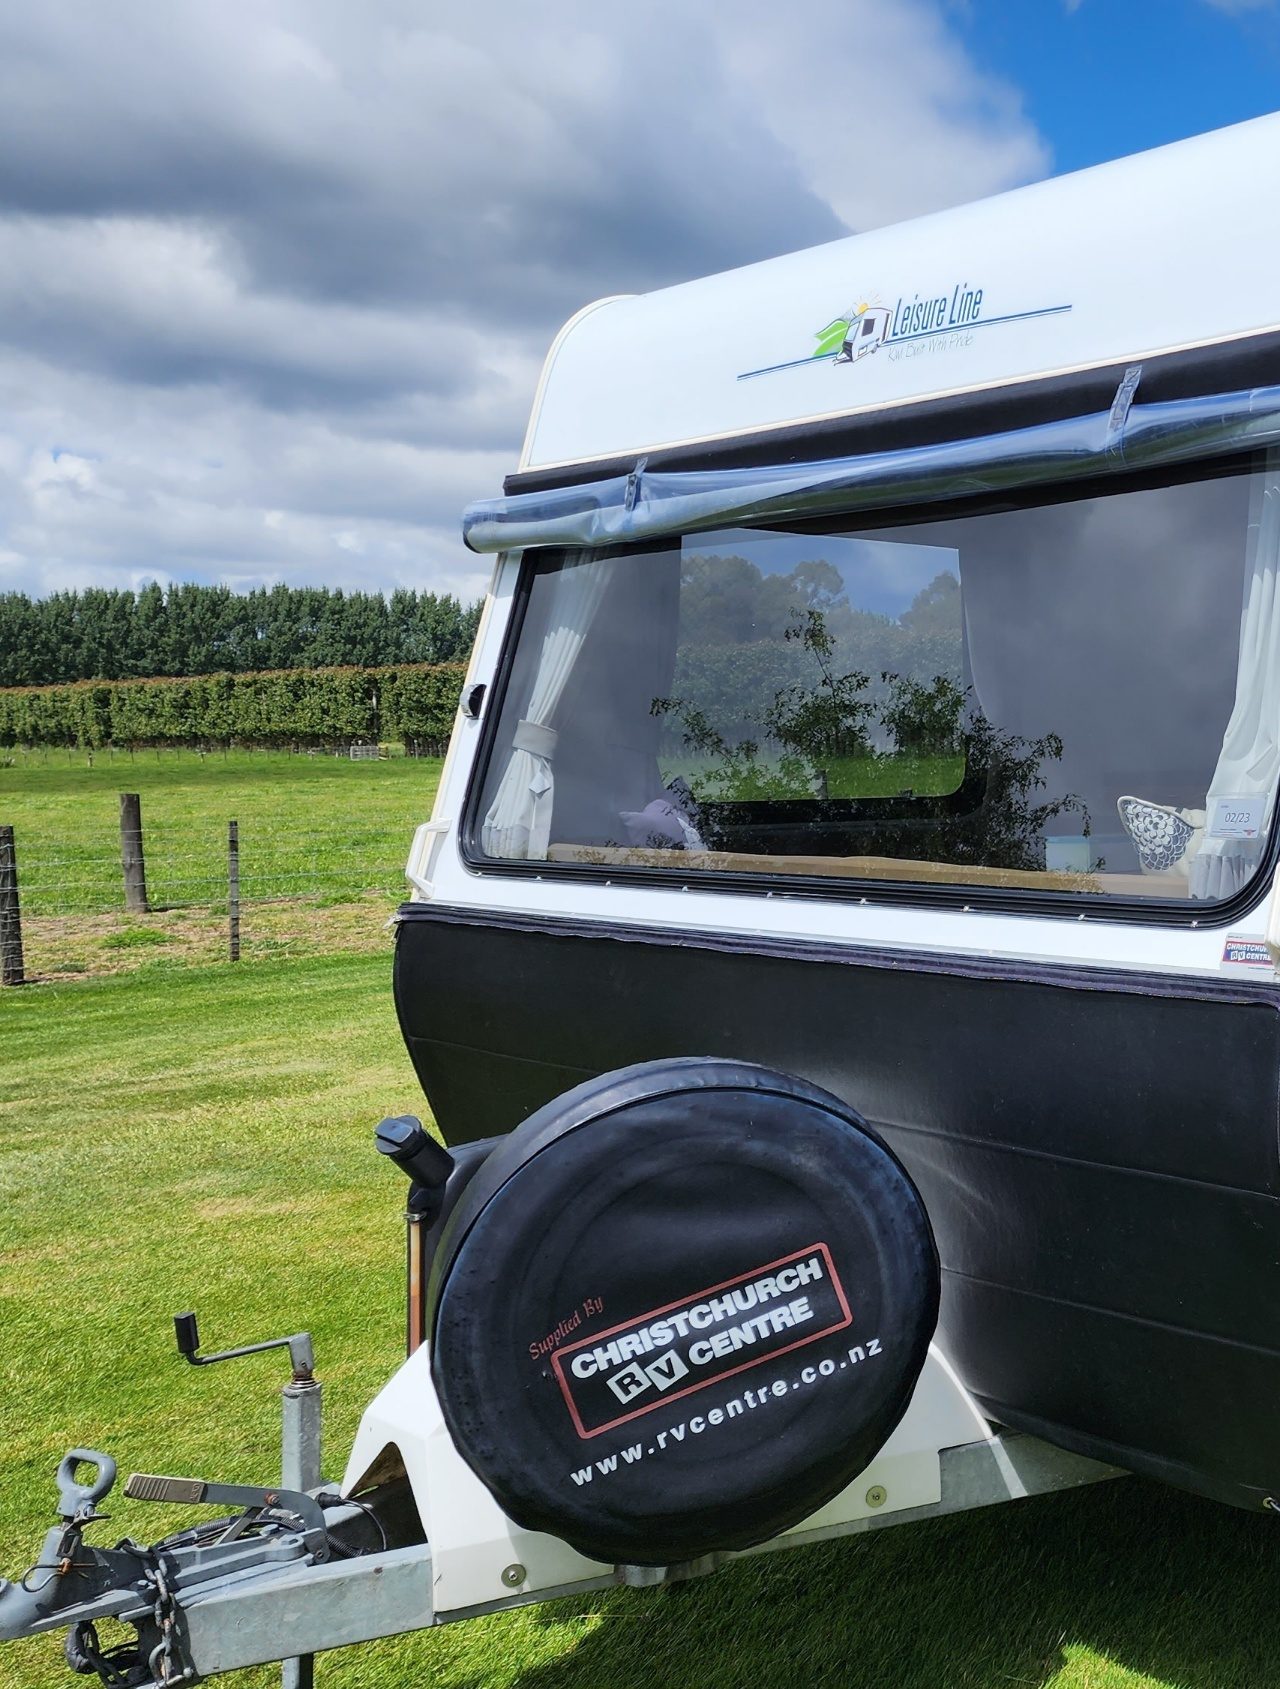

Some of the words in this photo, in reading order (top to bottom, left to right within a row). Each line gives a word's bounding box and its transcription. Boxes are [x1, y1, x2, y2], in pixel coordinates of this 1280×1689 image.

[891, 294, 947, 338] Leisure
[948, 283, 983, 325] Line
[1224, 812, 1251, 824] 02/23
[528, 1310, 582, 1360] Supplied
[583, 1296, 604, 1318] By
[570, 1257, 824, 1379] CHRISTCHURCH
[610, 1353, 685, 1402] RV
[688, 1296, 815, 1366] CENTRE
[569, 1337, 883, 1488] www.rvcentre.co.nz
